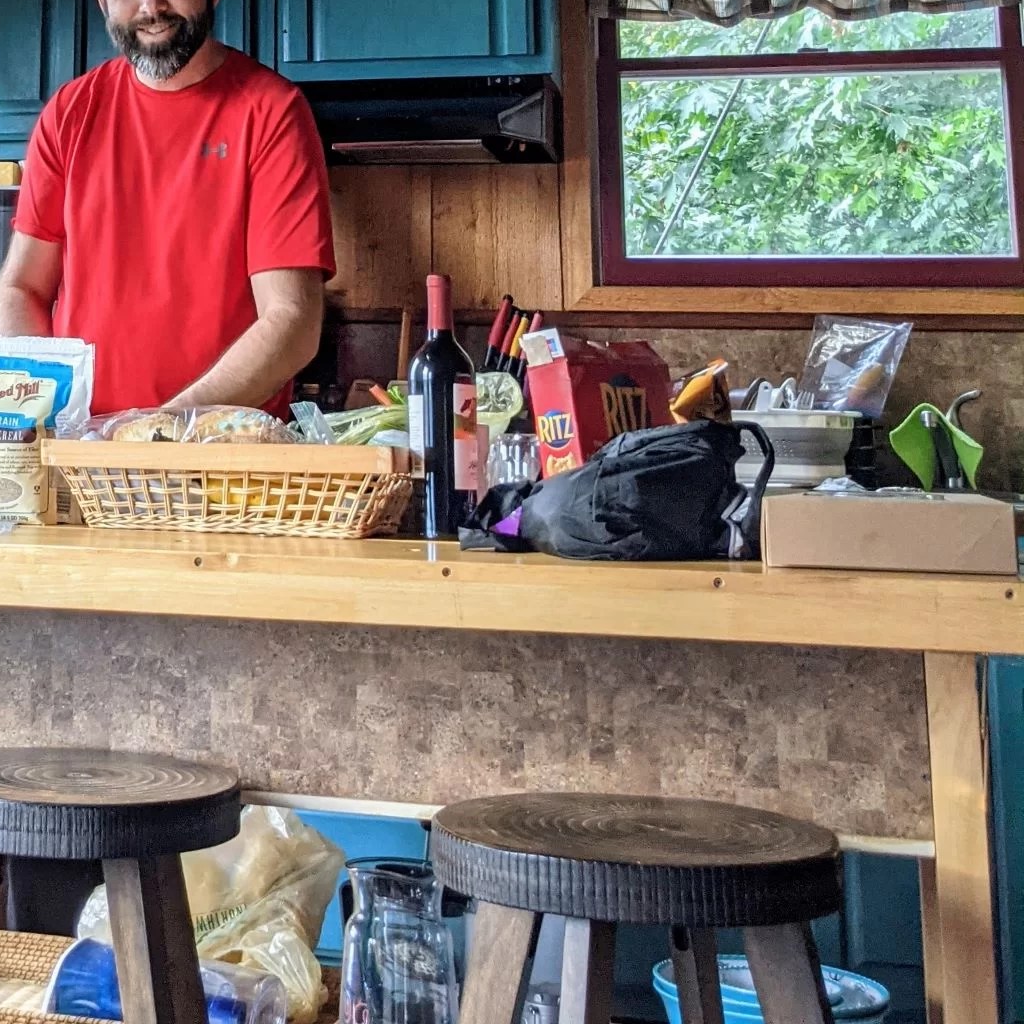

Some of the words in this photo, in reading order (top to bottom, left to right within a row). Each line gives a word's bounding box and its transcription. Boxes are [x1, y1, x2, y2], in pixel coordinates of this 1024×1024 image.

[14, 380, 40, 402] Mill
[599, 382, 647, 438] RITZ
[537, 413, 575, 444] RITZ
